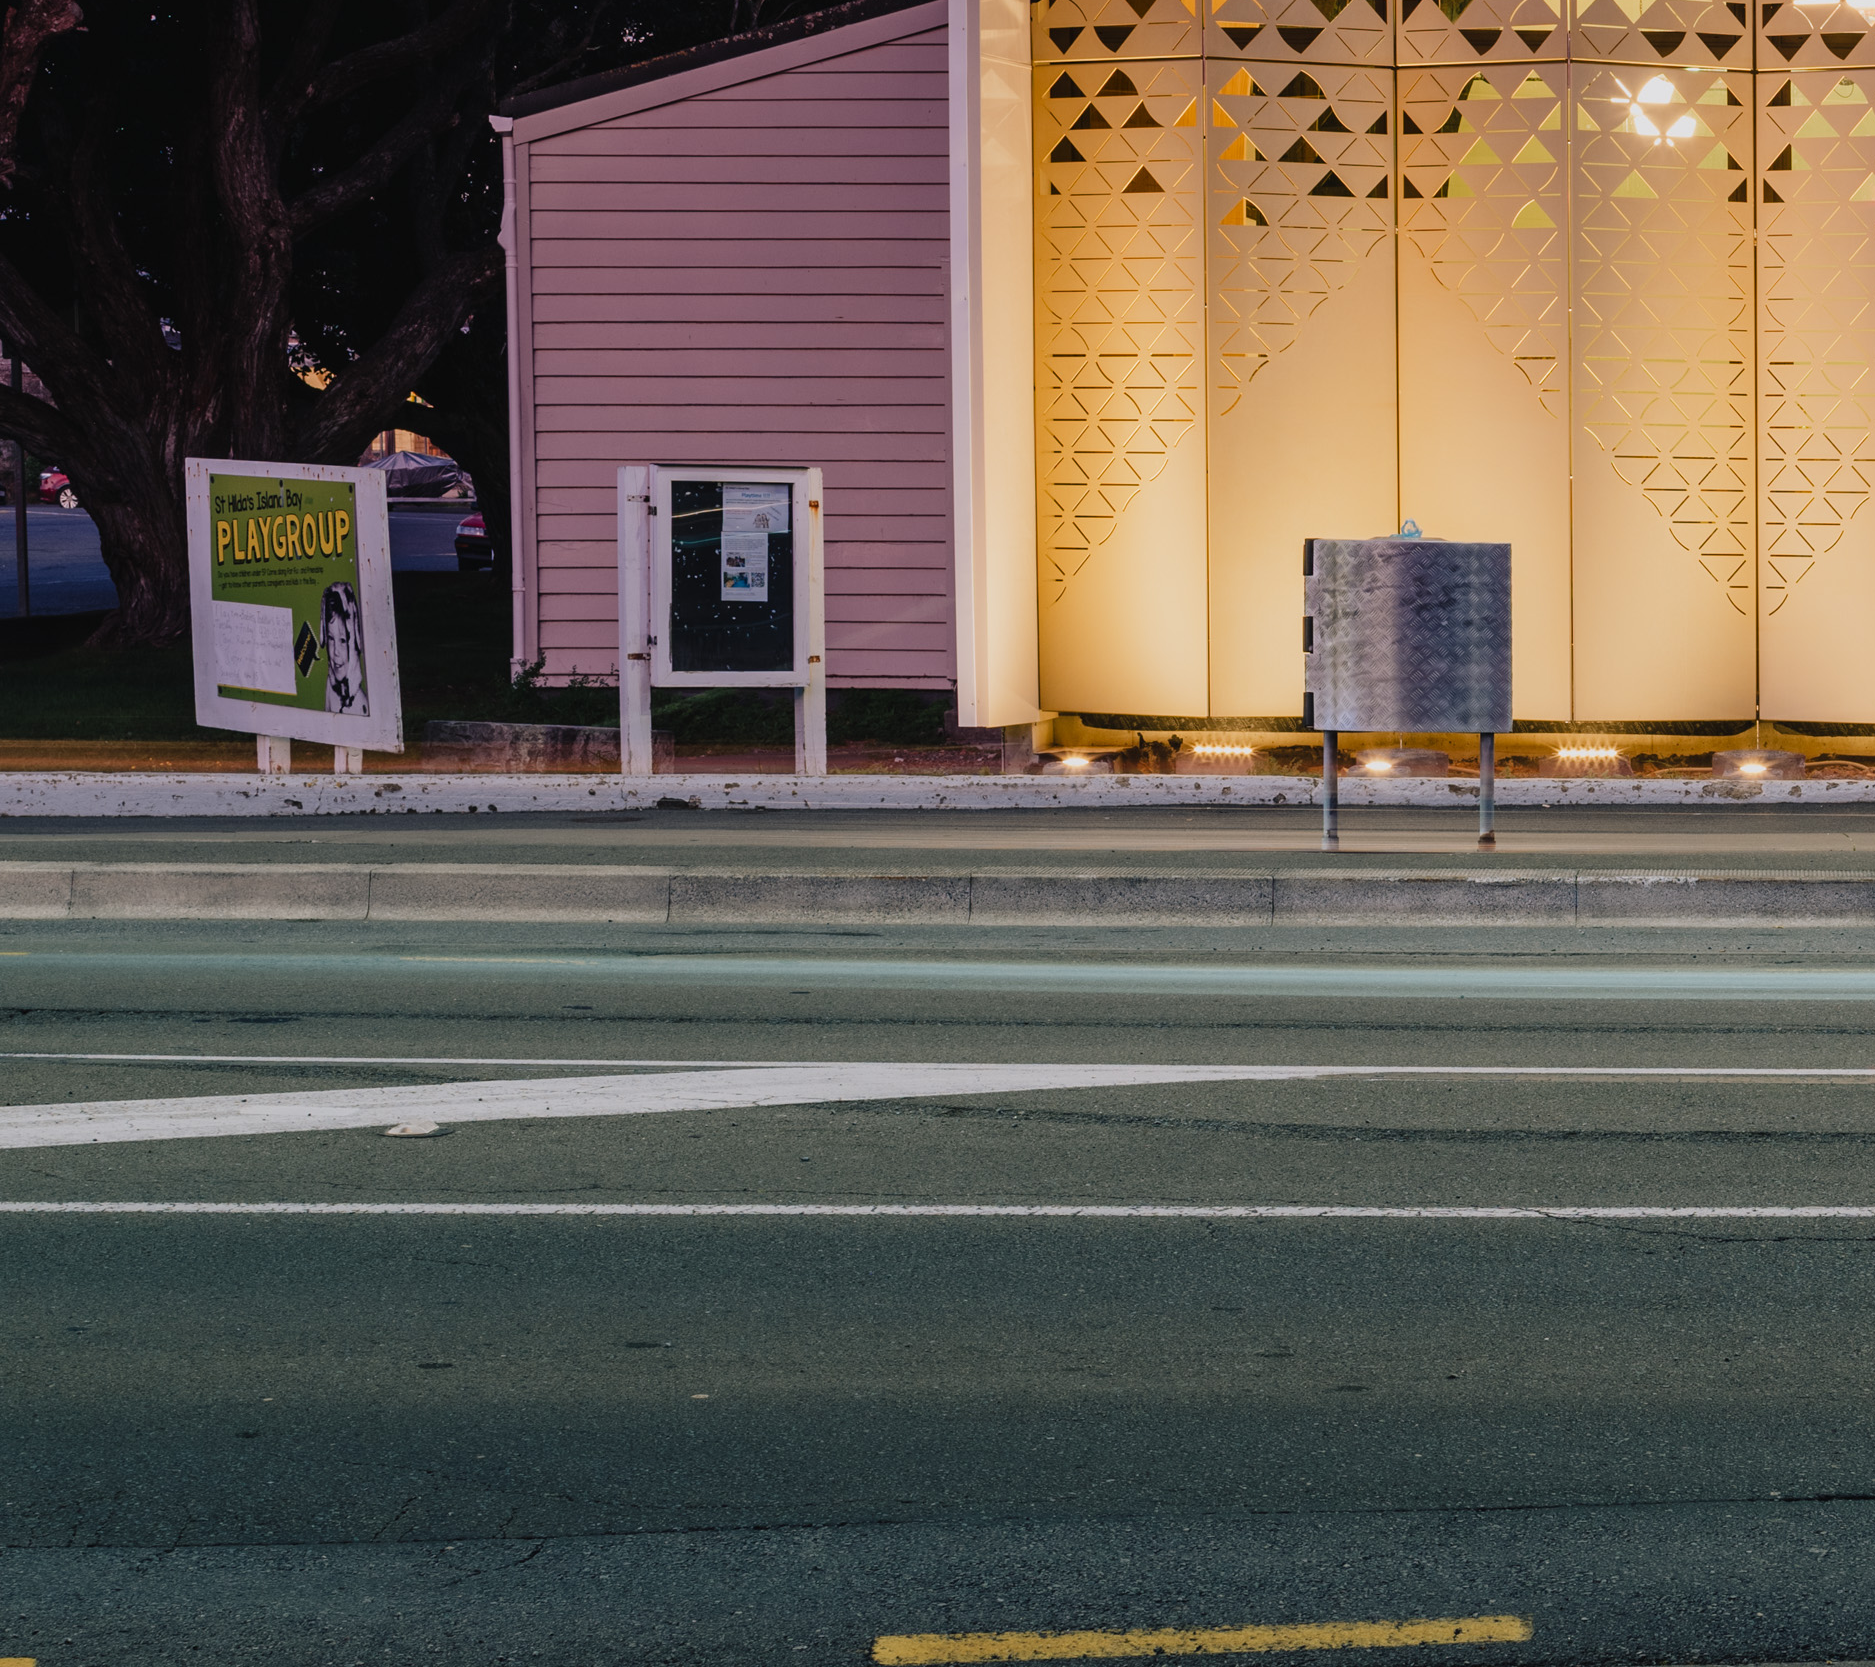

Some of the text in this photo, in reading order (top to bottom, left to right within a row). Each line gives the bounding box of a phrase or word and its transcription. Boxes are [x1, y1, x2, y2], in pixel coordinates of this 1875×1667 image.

[214, 489, 303, 514] St Hilda's Island Bay
[216, 509, 350, 566] PLAYGROUP
